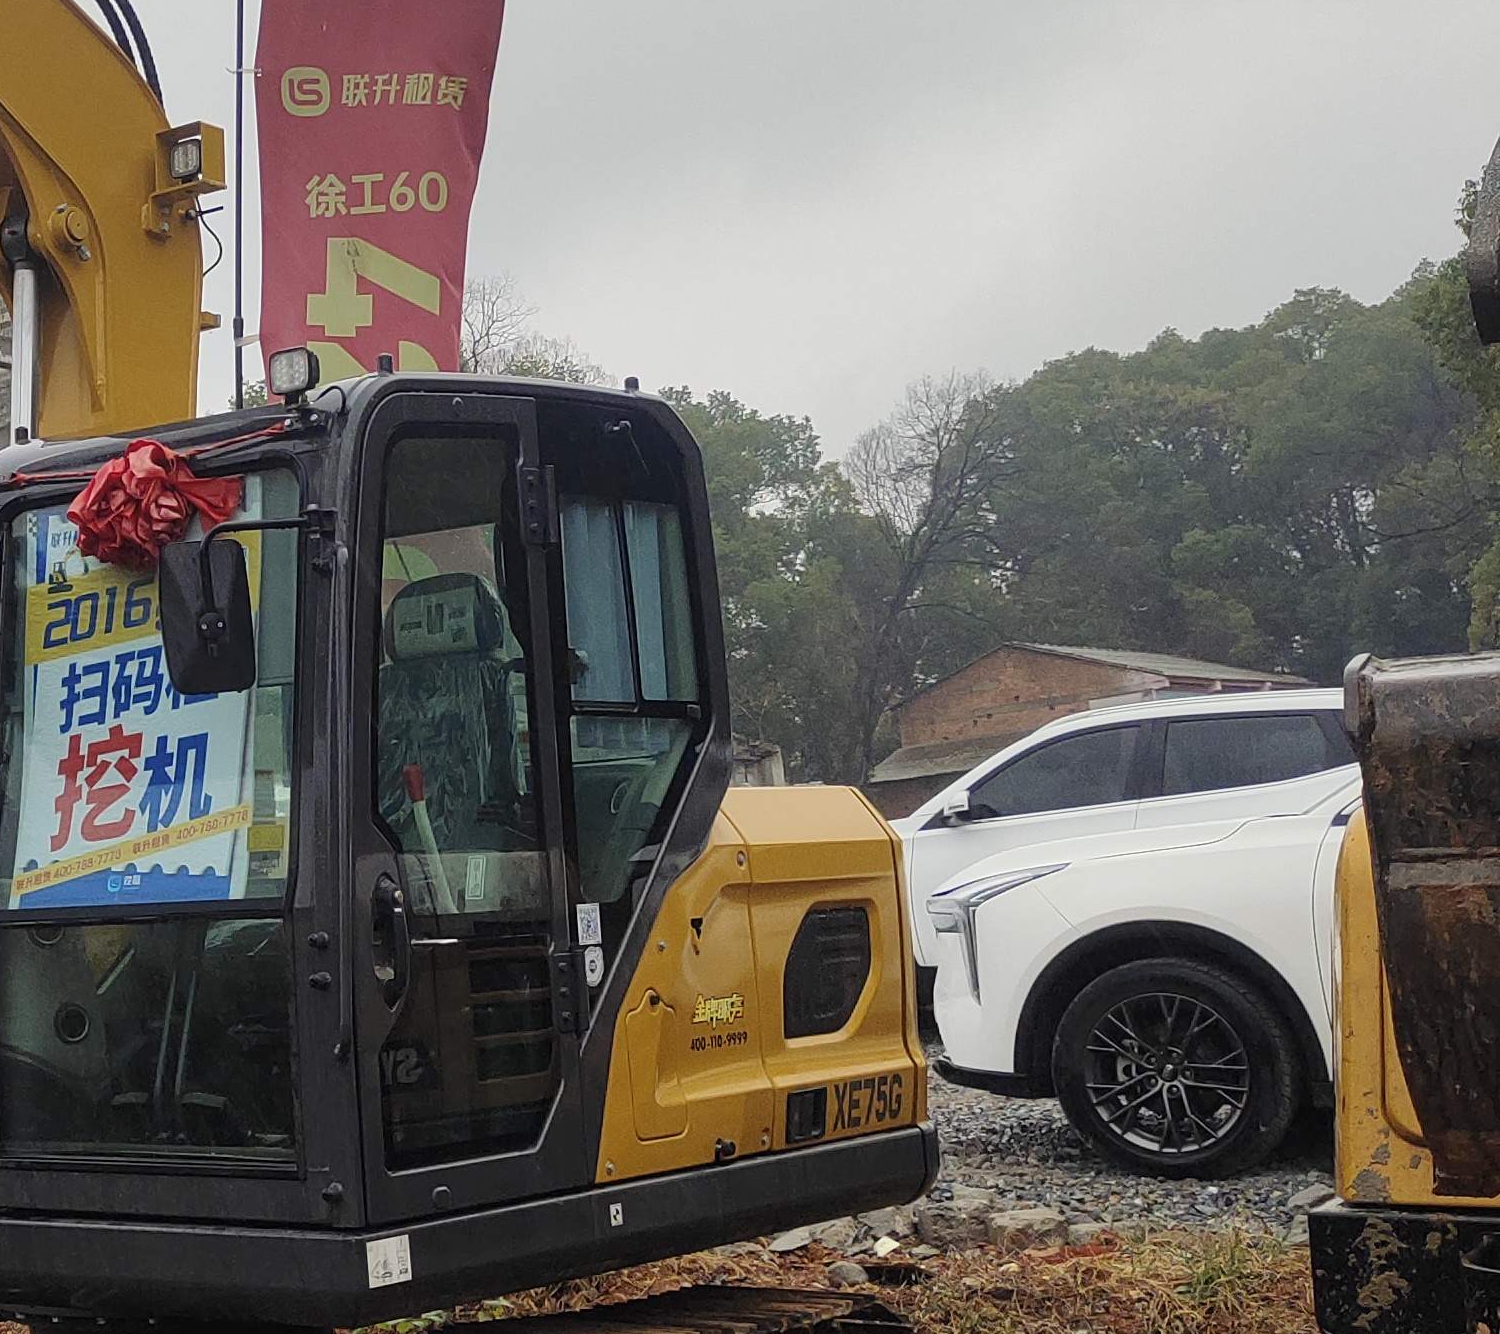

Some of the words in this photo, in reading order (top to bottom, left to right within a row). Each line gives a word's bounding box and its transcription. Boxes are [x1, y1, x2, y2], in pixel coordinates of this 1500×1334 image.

[340, 72, 469, 111] 联升租赁
[304, 171, 449, 218] 徐工60
[43, 578, 161, 649] 2016
[50, 723, 213, 853] 挖机
[691, 1031, 748, 1052] 400-110-9999
[833, 1073, 903, 1131] XE75G
